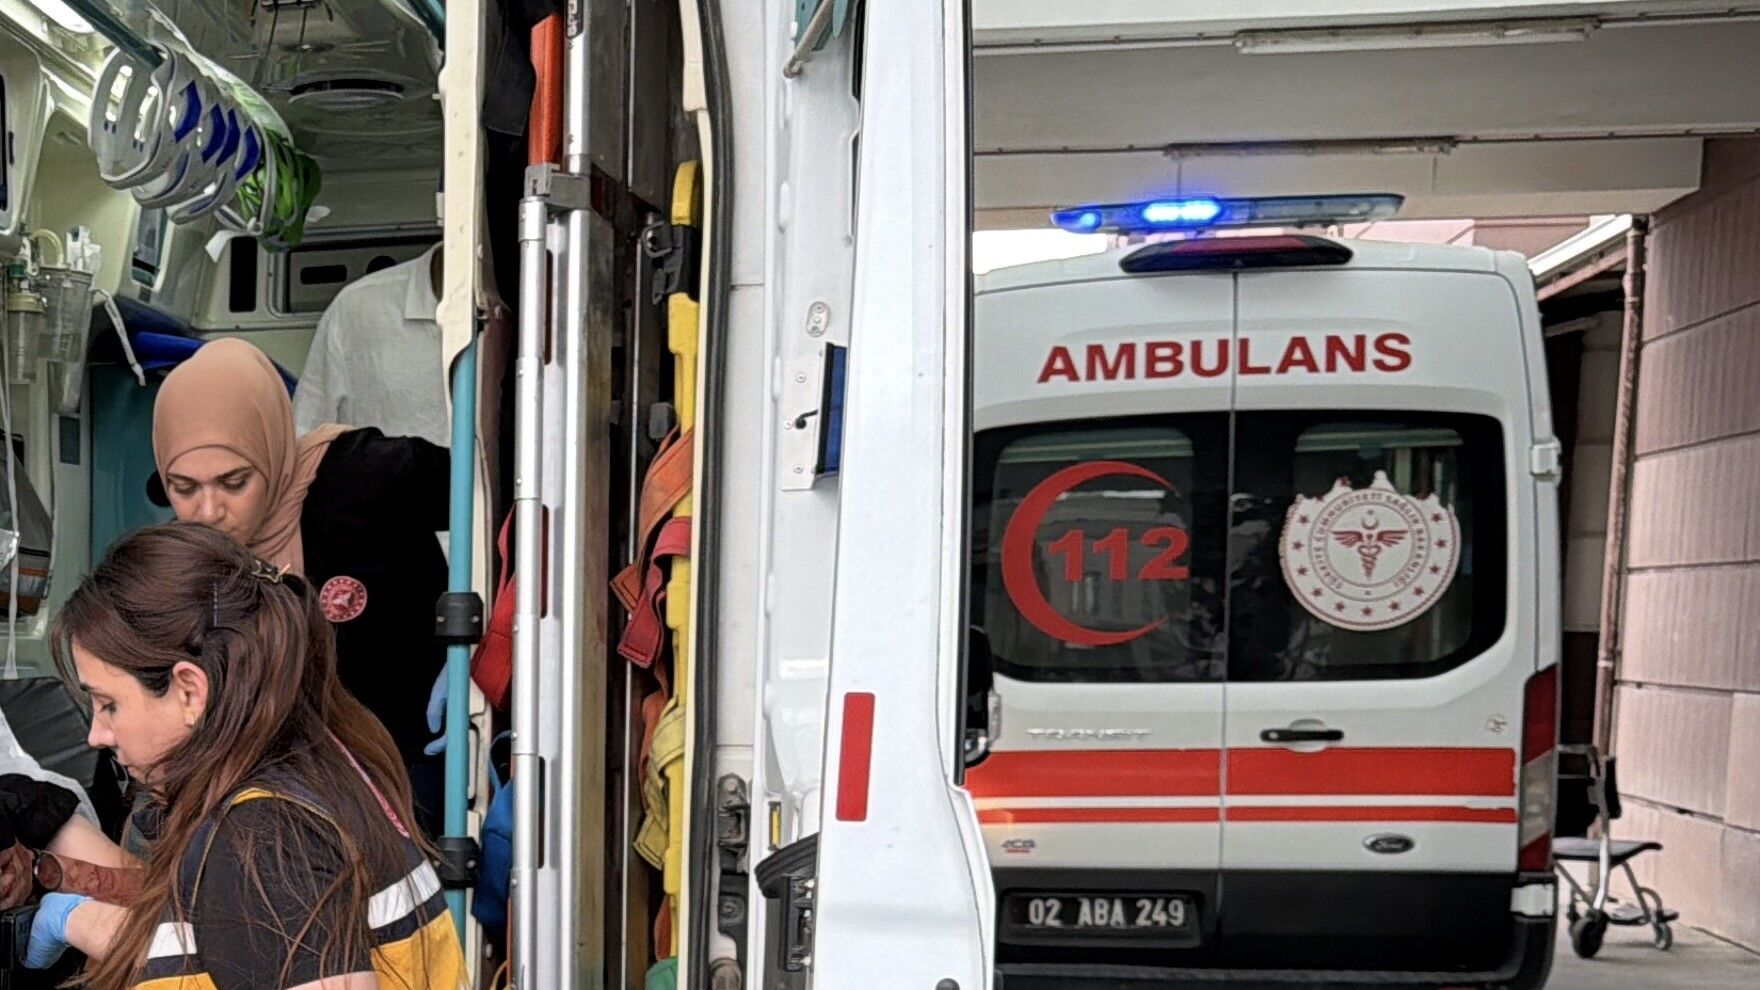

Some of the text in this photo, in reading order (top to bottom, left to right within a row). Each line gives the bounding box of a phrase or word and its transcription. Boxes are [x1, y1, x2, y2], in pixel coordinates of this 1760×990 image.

[1038, 332, 1412, 384] AMBULANS
[1048, 526, 1190, 582] 112
[1029, 898, 1184, 928] 02 ABA 249
